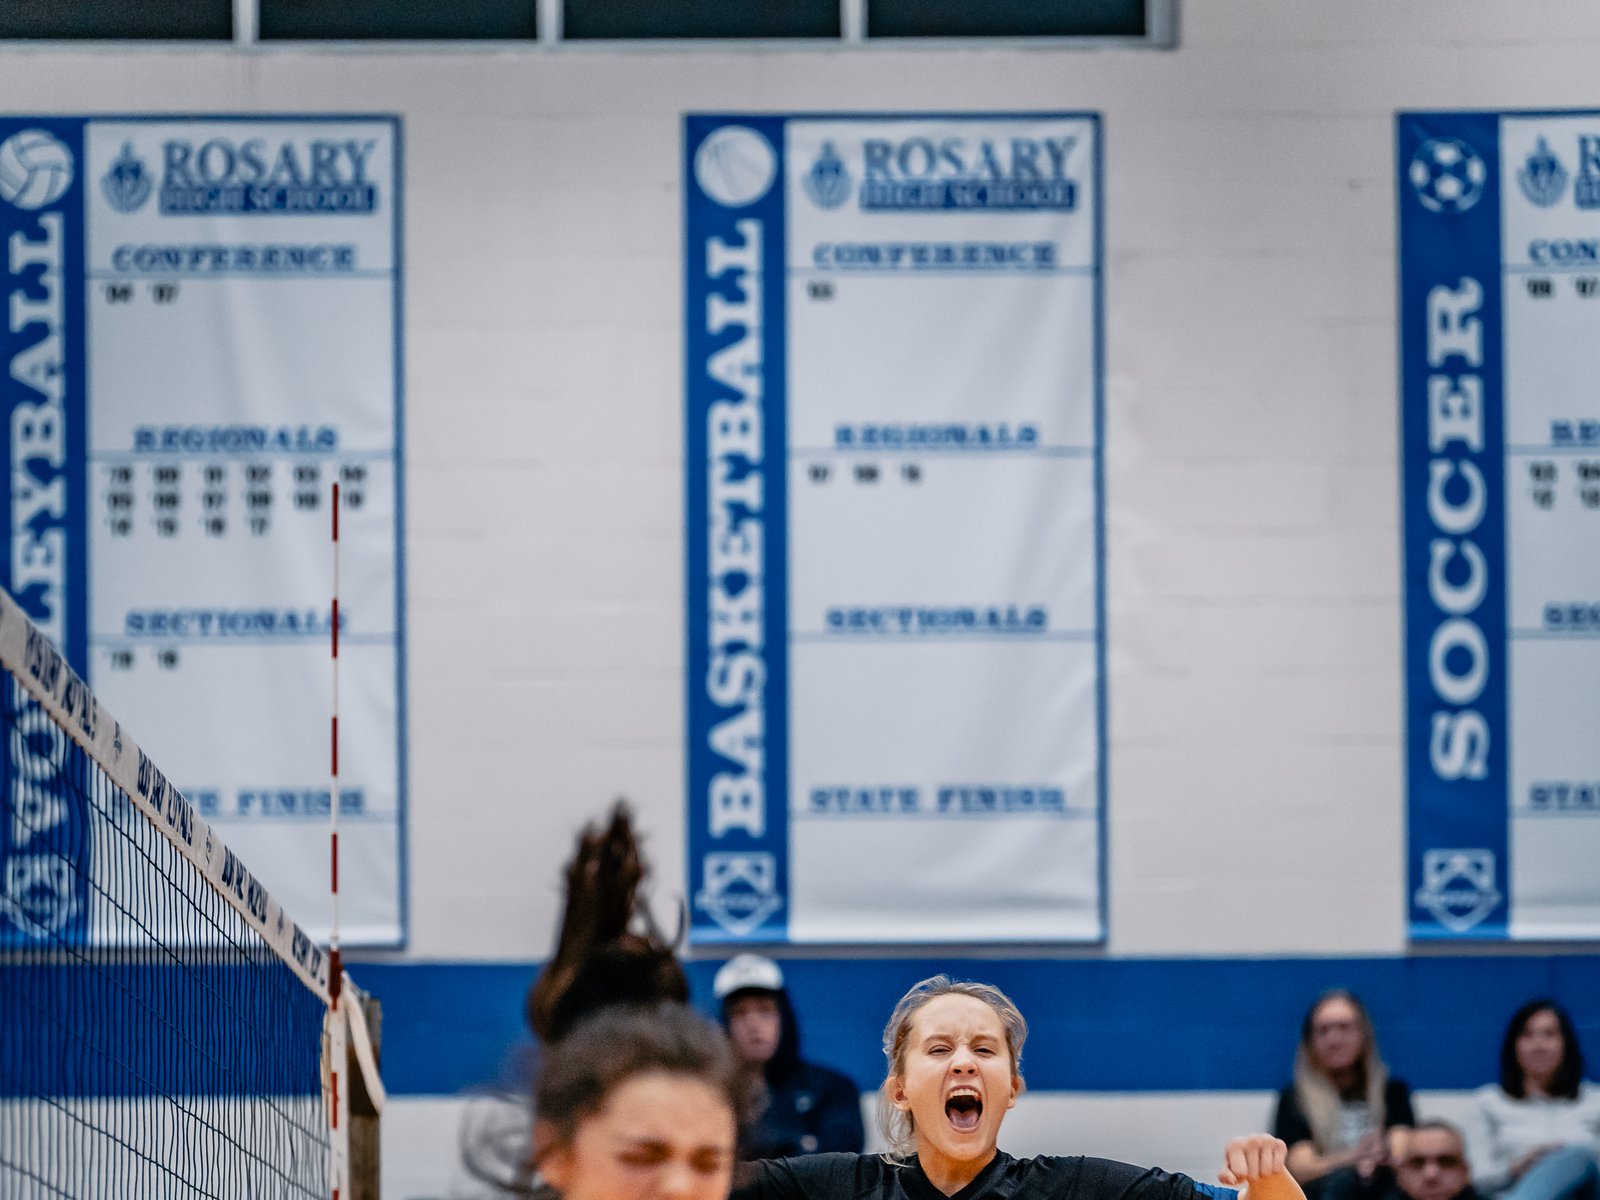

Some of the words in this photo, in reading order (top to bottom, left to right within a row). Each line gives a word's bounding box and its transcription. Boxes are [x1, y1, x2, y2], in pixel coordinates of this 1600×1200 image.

[162, 139, 377, 187] ROSARY
[862, 137, 1078, 181] ROSARY
[111, 244, 357, 272] CONFERENCE
[811, 242, 1057, 268] CONFERENCE
[134, 425, 338, 453] REGIONALS
[834, 424, 1040, 449] REGIONALS
[706, 218, 763, 838] BASKETBALL
[1426, 276, 1488, 781] SOCCER
[125, 609, 347, 636] SECTIONALS
[825, 607, 1049, 633] SECTIONALS
[810, 786, 921, 812] STATE
[937, 786, 1066, 812] FINISH
